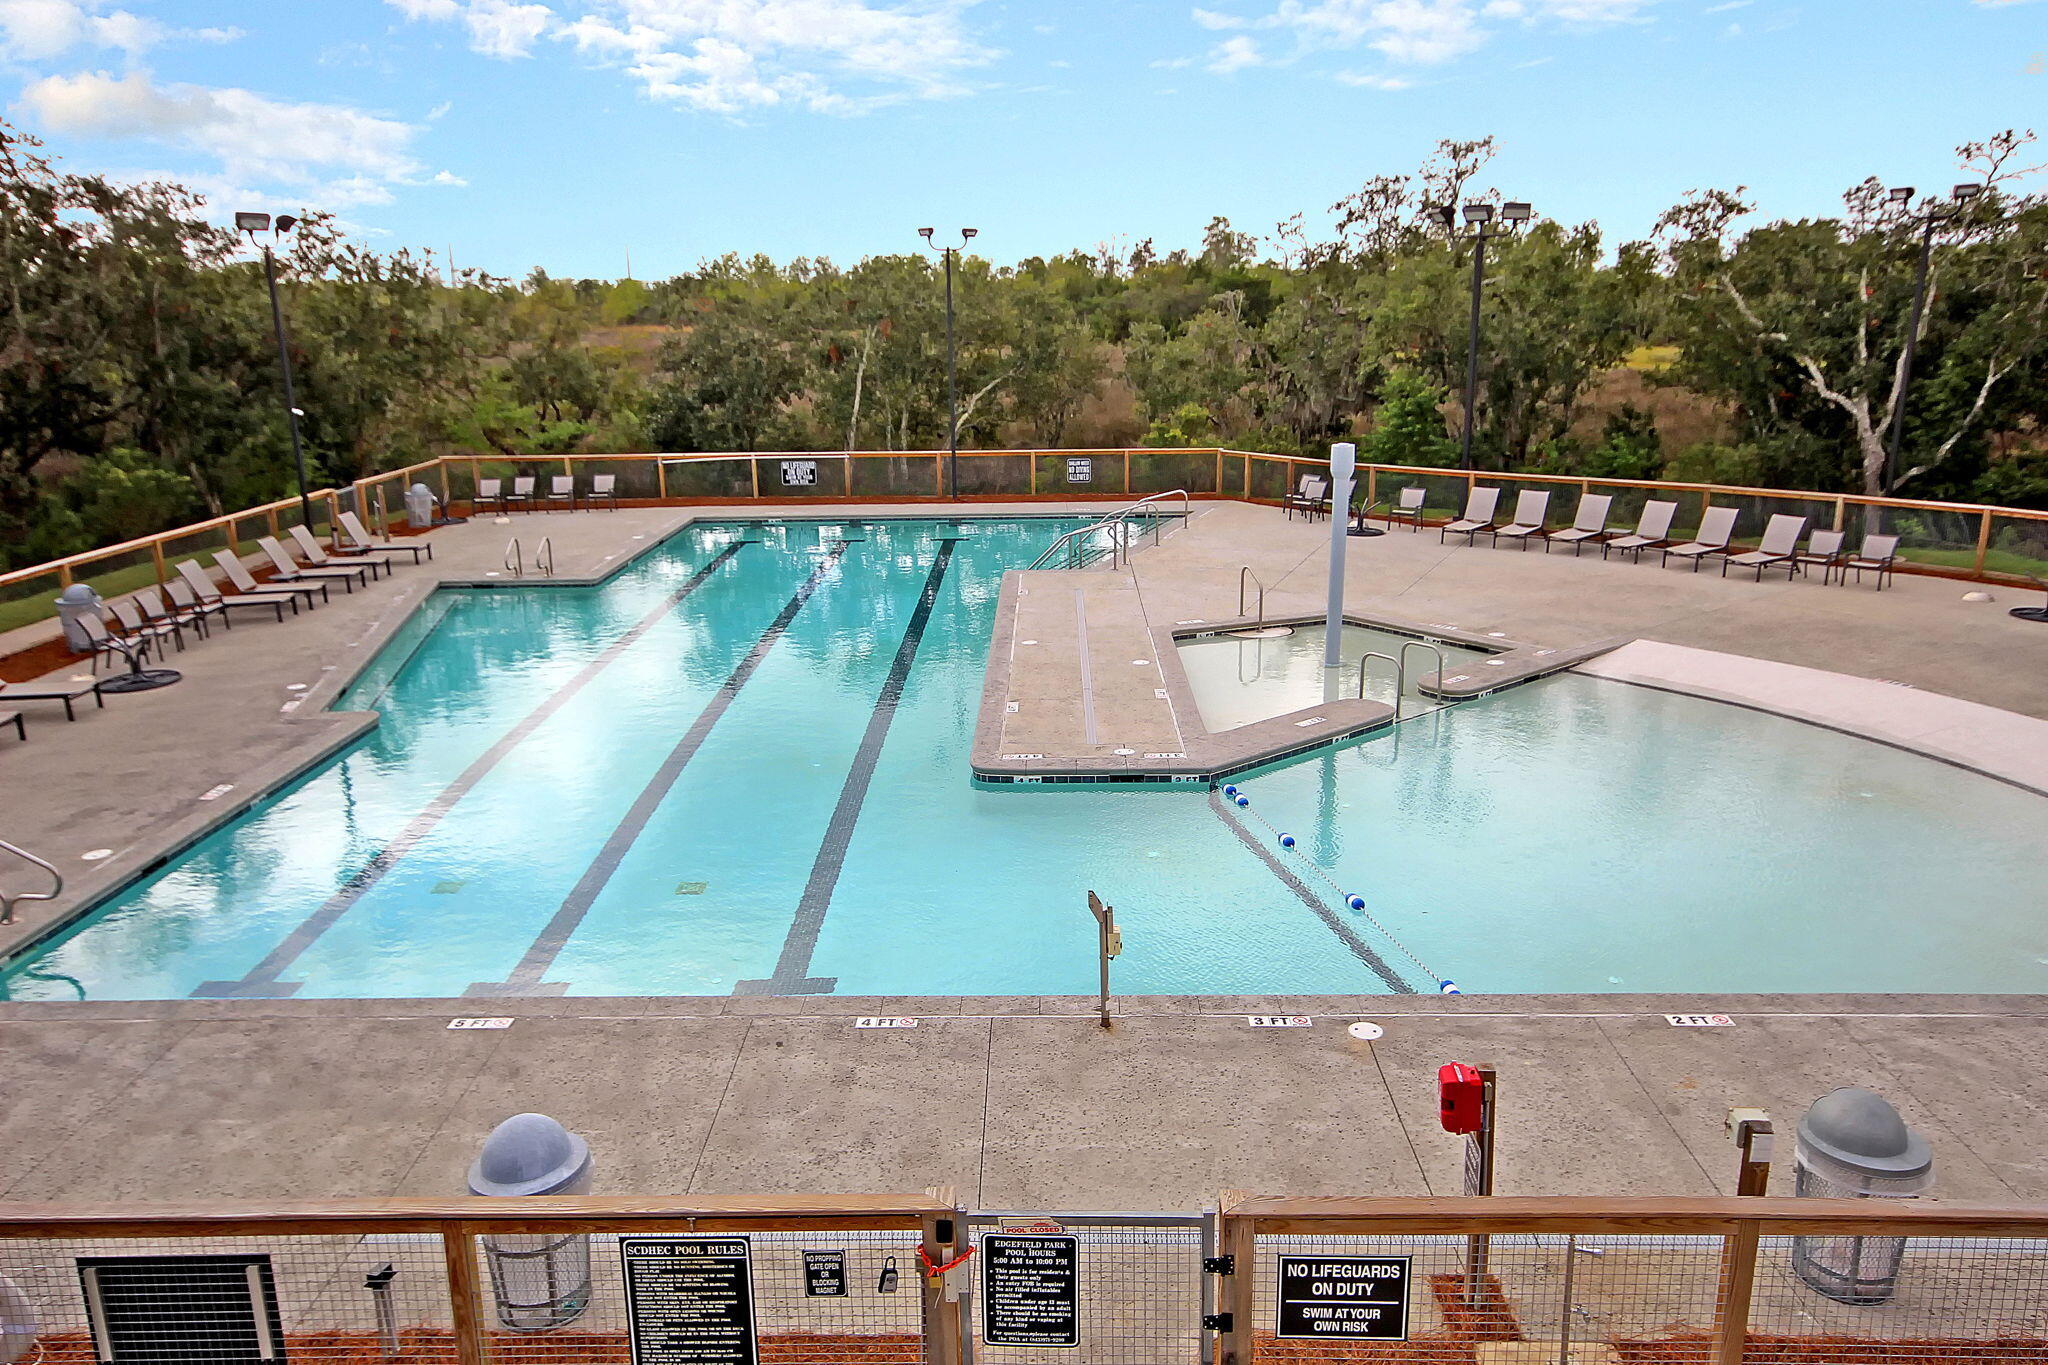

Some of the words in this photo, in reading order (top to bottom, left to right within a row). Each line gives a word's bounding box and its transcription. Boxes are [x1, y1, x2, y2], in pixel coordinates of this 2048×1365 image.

[861, 1018, 871, 1026] 4
[877, 1018, 896, 1026] FT
[1254, 1018, 1264, 1026] 3
[1689, 1016, 1709, 1024] FT
[675, 1246, 703, 1254] POOL
[707, 1246, 743, 1254] RULES
[1288, 1264, 1308, 1277] NO
[1312, 1265, 1400, 1278] LIFEGUARDS
[1312, 1282, 1333, 1295] ON
[1337, 1283, 1374, 1296] DUTY
[1303, 1308, 1332, 1318] SWIM
[1335, 1309, 1347, 1319] AT
[1350, 1309, 1380, 1319] YOUR
[1314, 1321, 1340, 1331] OWN
[1342, 1322, 1368, 1332] RISK
